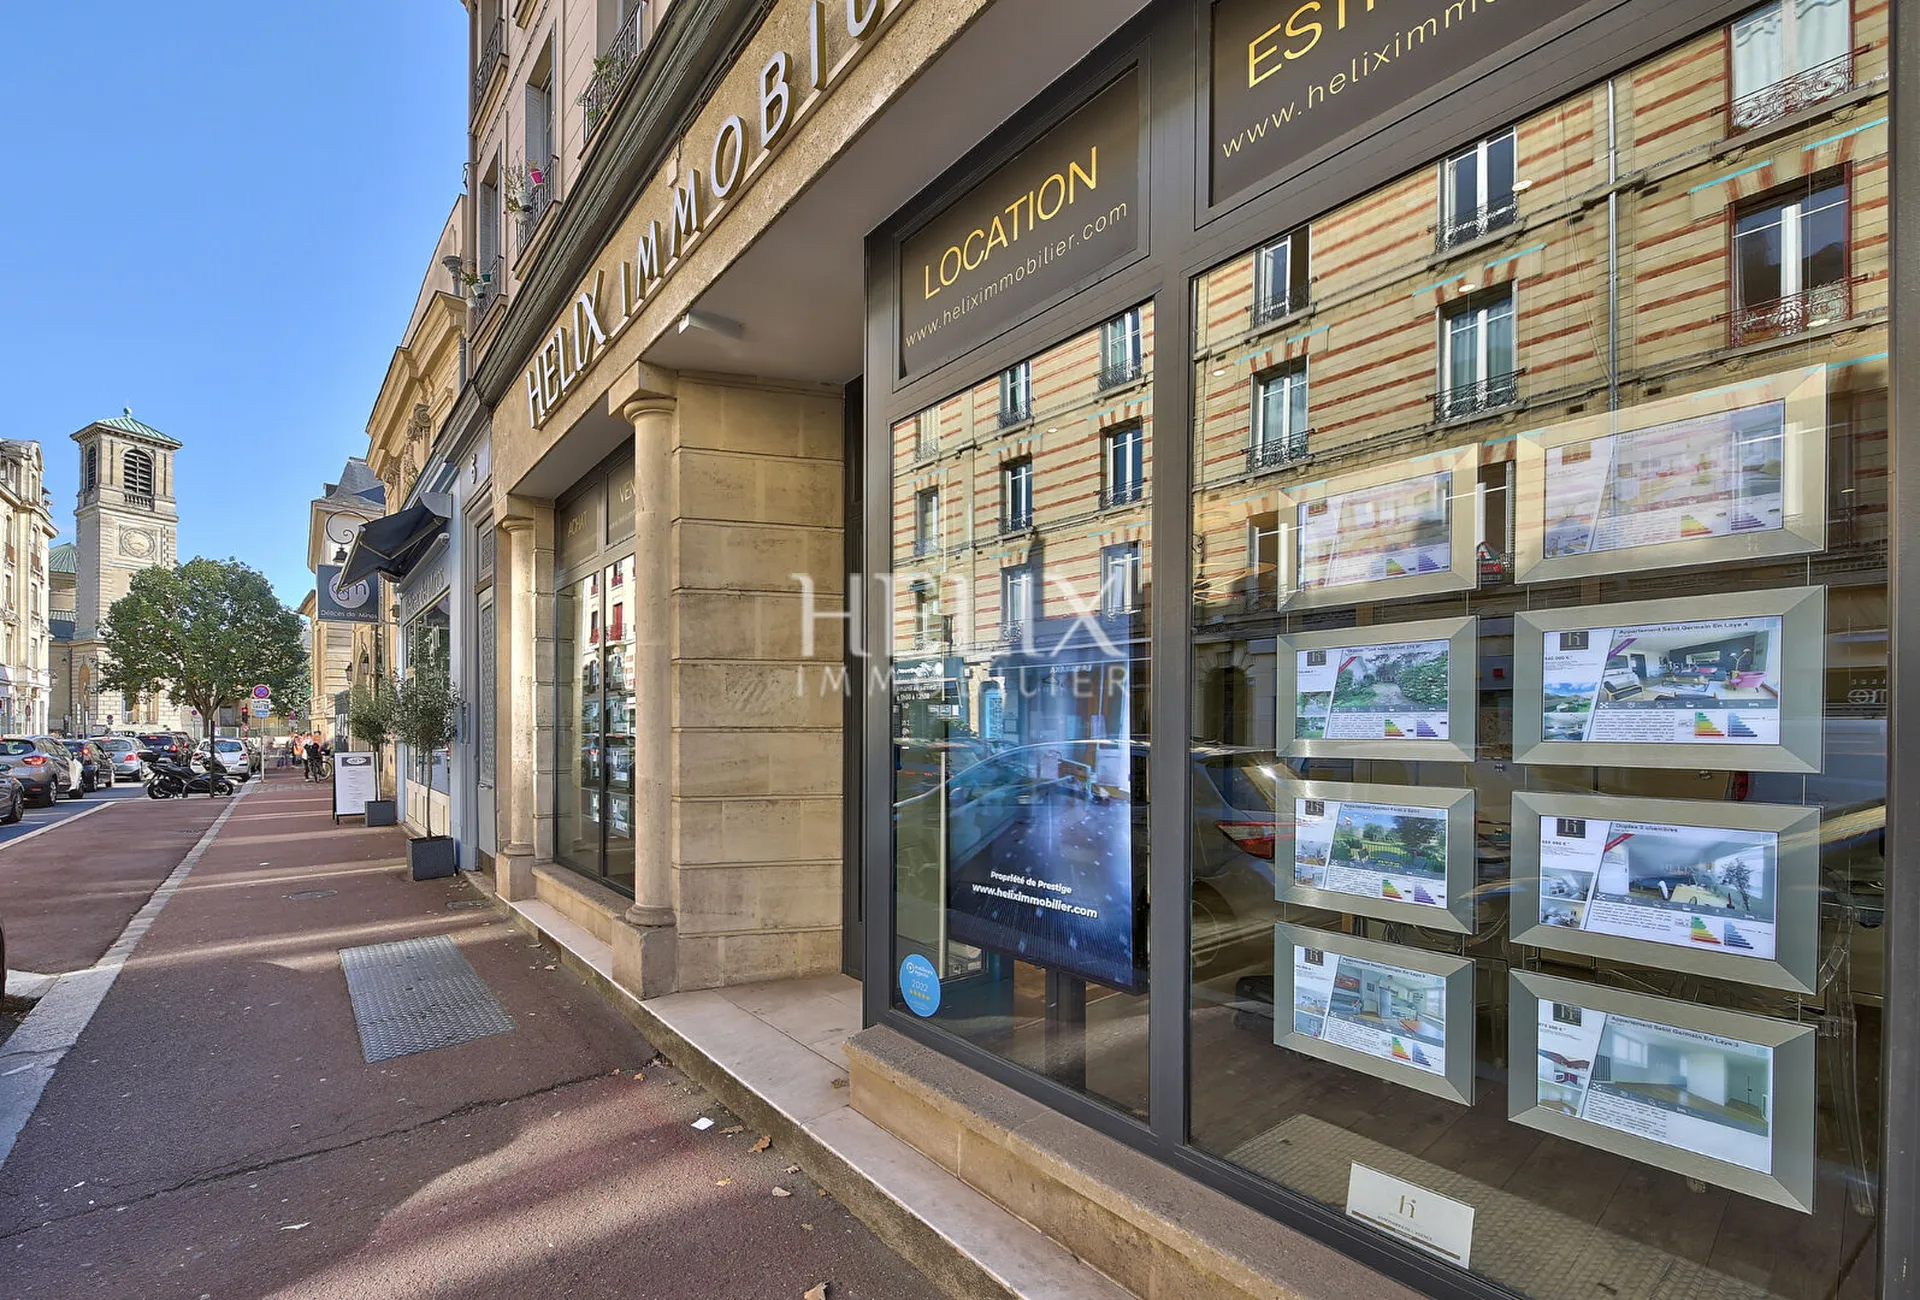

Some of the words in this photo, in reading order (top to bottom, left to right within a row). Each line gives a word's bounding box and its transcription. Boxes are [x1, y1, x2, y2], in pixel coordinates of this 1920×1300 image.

[904, 202, 1128, 347] www.heliximmobilier.com
[924, 146, 1097, 299] LOCATION
[526, 270, 611, 429] HELIX
[972, 884, 1098, 919] www.heliximmobilier.com
[990, 870, 1025, 885] Propriété
[1026, 877, 1037, 888] de
[1037, 879, 1073, 895] Prestige
